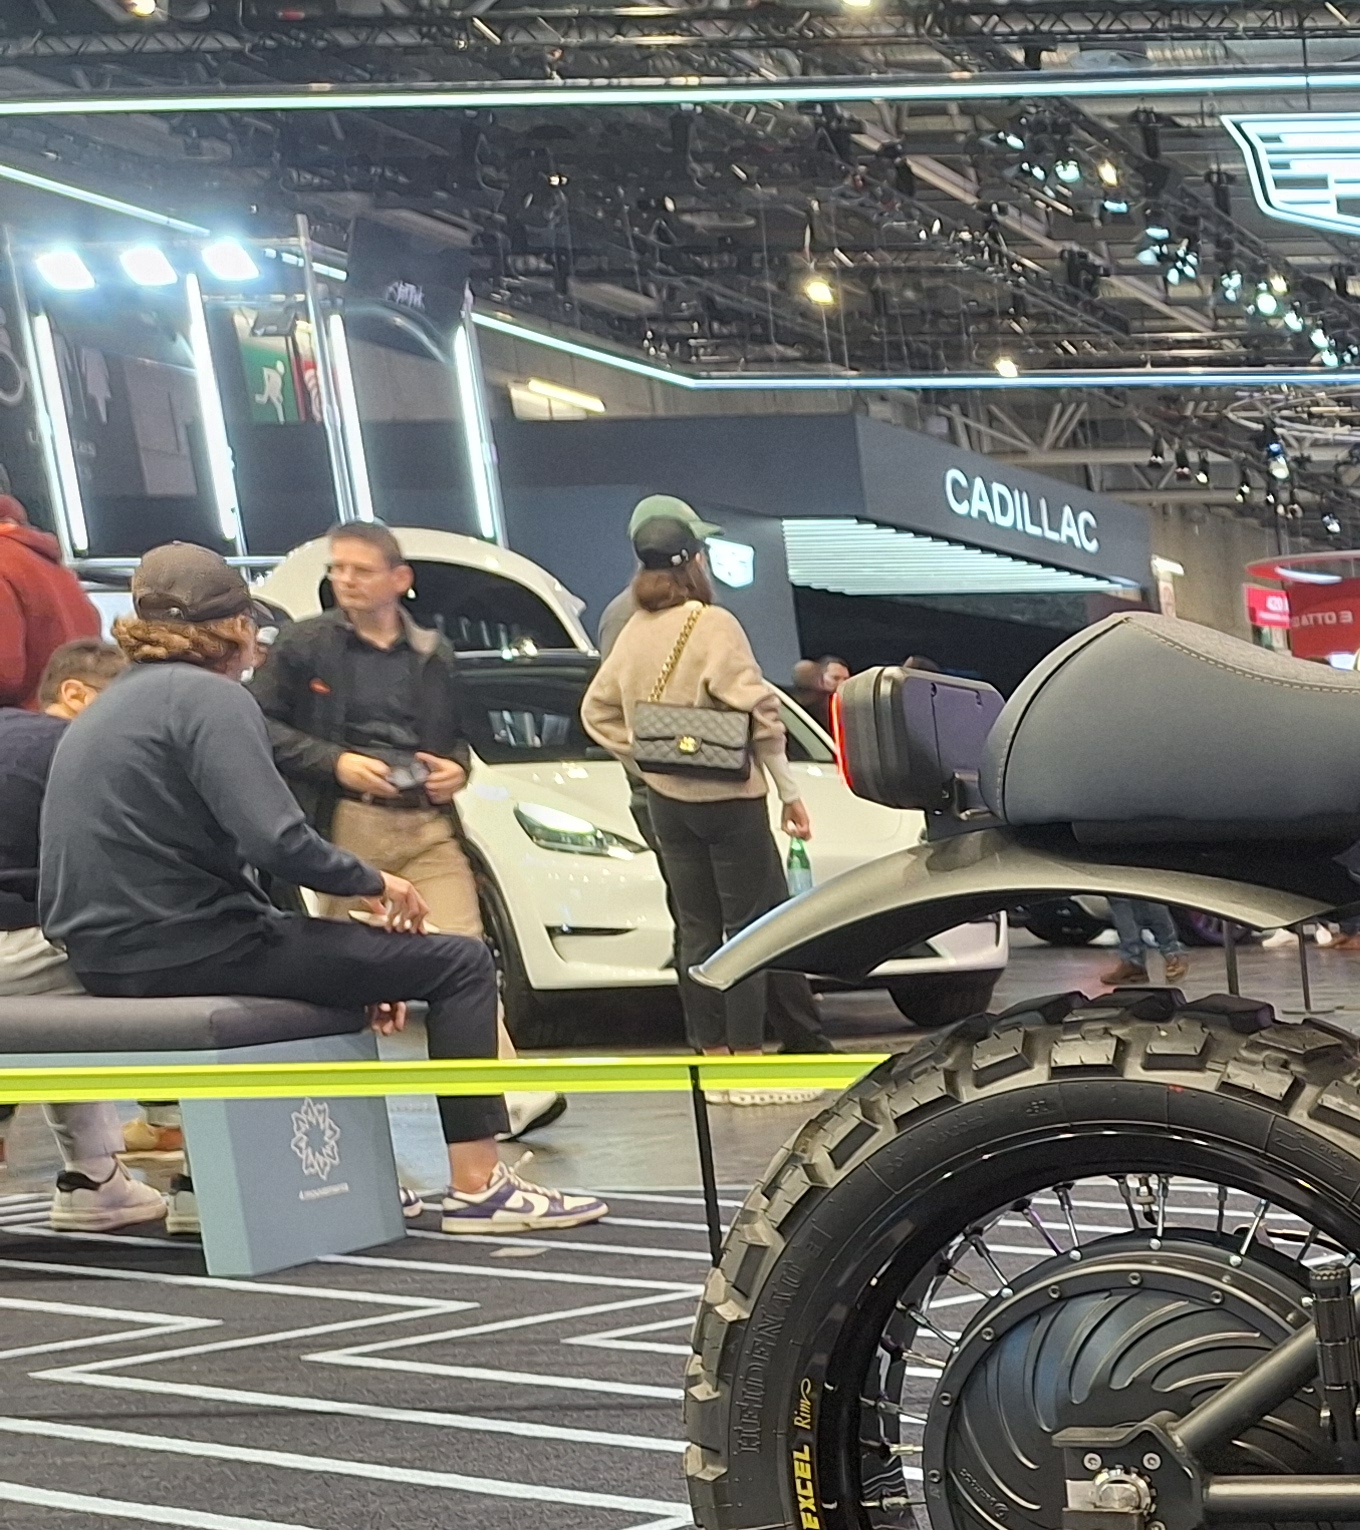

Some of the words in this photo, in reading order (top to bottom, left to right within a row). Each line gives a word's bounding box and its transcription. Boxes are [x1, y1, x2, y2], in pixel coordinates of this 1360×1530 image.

[945, 468, 1099, 553] CADILLAC
[794, 1377, 812, 1430] Rim
[793, 1445, 820, 1530] EXCEL
